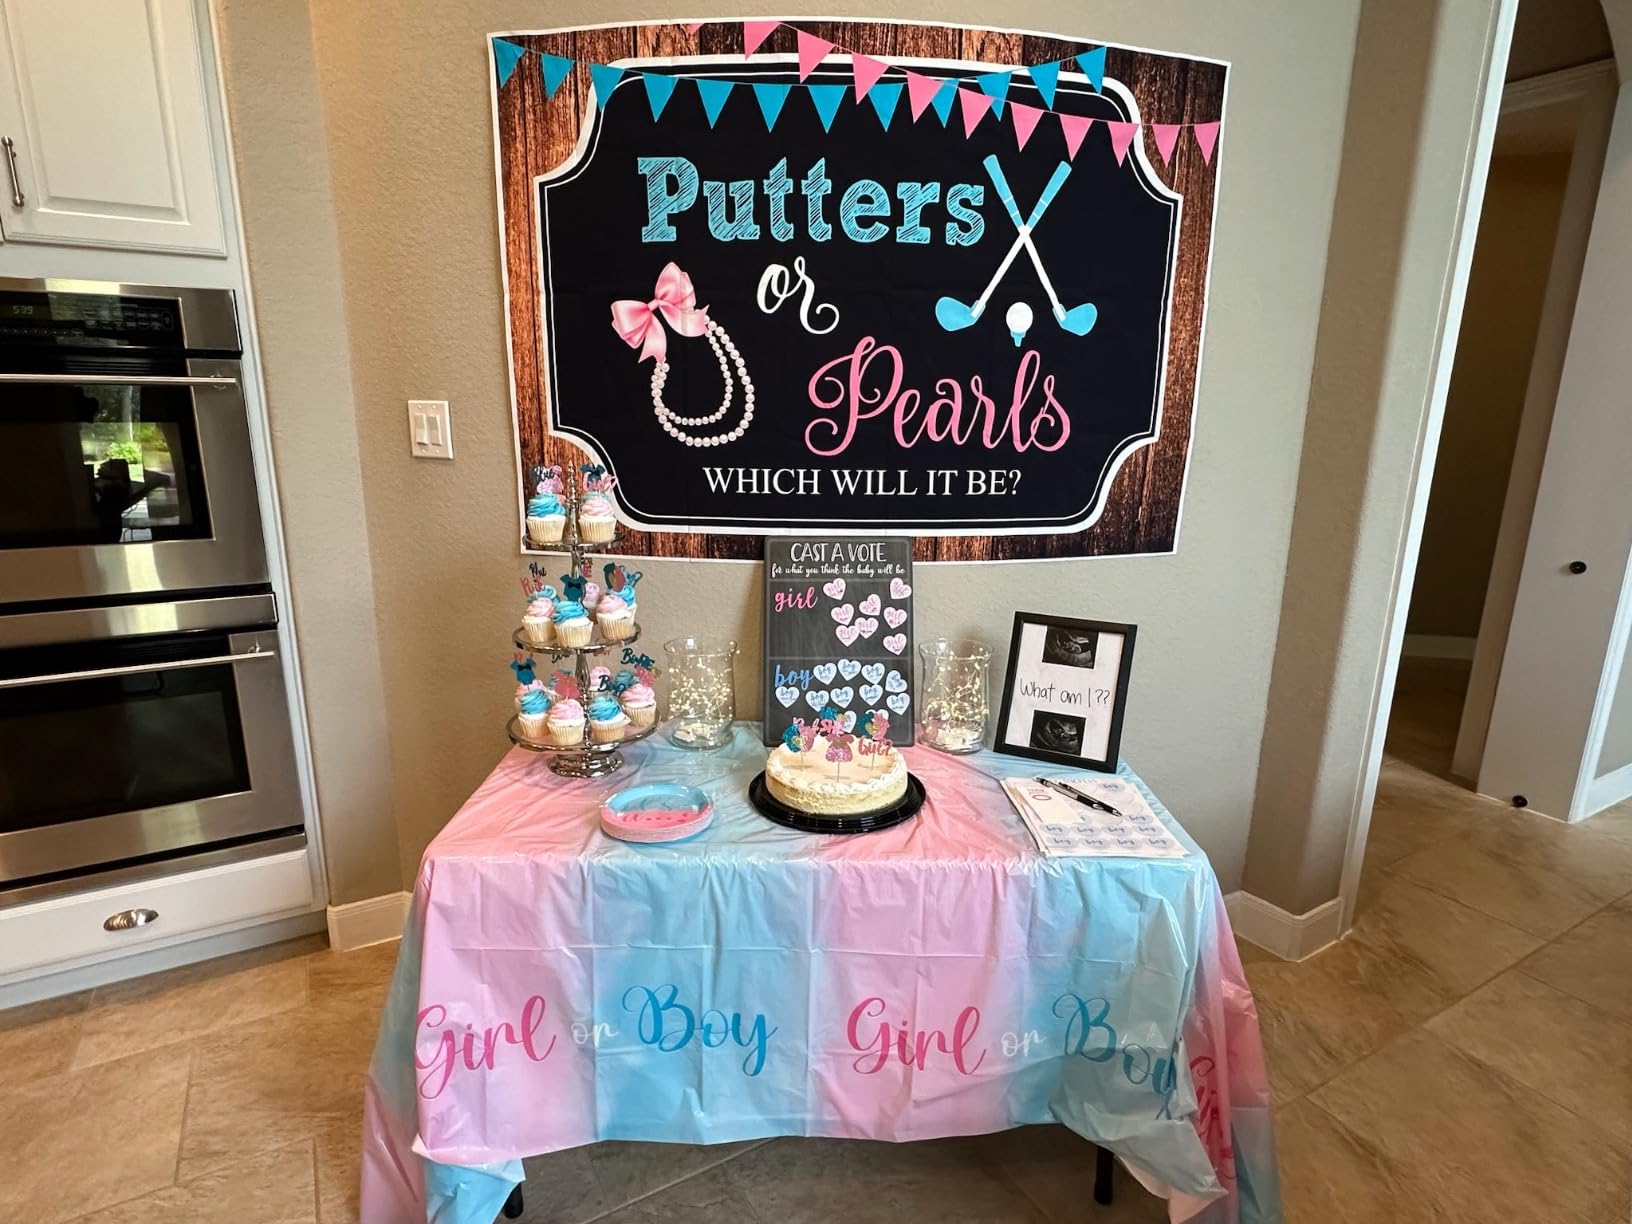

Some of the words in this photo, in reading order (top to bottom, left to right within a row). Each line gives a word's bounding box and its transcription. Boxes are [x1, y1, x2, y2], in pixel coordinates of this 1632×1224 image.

[637, 156, 986, 246] Putters
[756, 256, 840, 335] or
[804, 336, 1071, 457] Pearls
[702, 467, 822, 495] WHICH
[829, 469, 918, 496] WILL
[925, 469, 959, 496] IT
[965, 469, 1022, 496] BE?
[790, 542, 829, 562] CAST
[831, 542, 845, 562] A
[847, 542, 887, 562] VOTE
[771, 563, 783, 578] for
[785, 563, 803, 574] what
[806, 567, 818, 578] you
[821, 563, 840, 575] think
[842, 563, 854, 575] the
[857, 563, 875, 578] baby
[878, 564, 893, 575] will
[895, 564, 906, 574] be
[774, 586, 818, 612] girl
[774, 664, 815, 690] boy
[1020, 678, 1056, 703] What
[1060, 690, 1082, 705] am
[415, 995, 557, 1099] Girl
[570, 1021, 620, 1047] or
[621, 983, 779, 1077] Boy
[846, 997, 987, 1075] Girl
[1001, 1030, 1047, 1058] or
